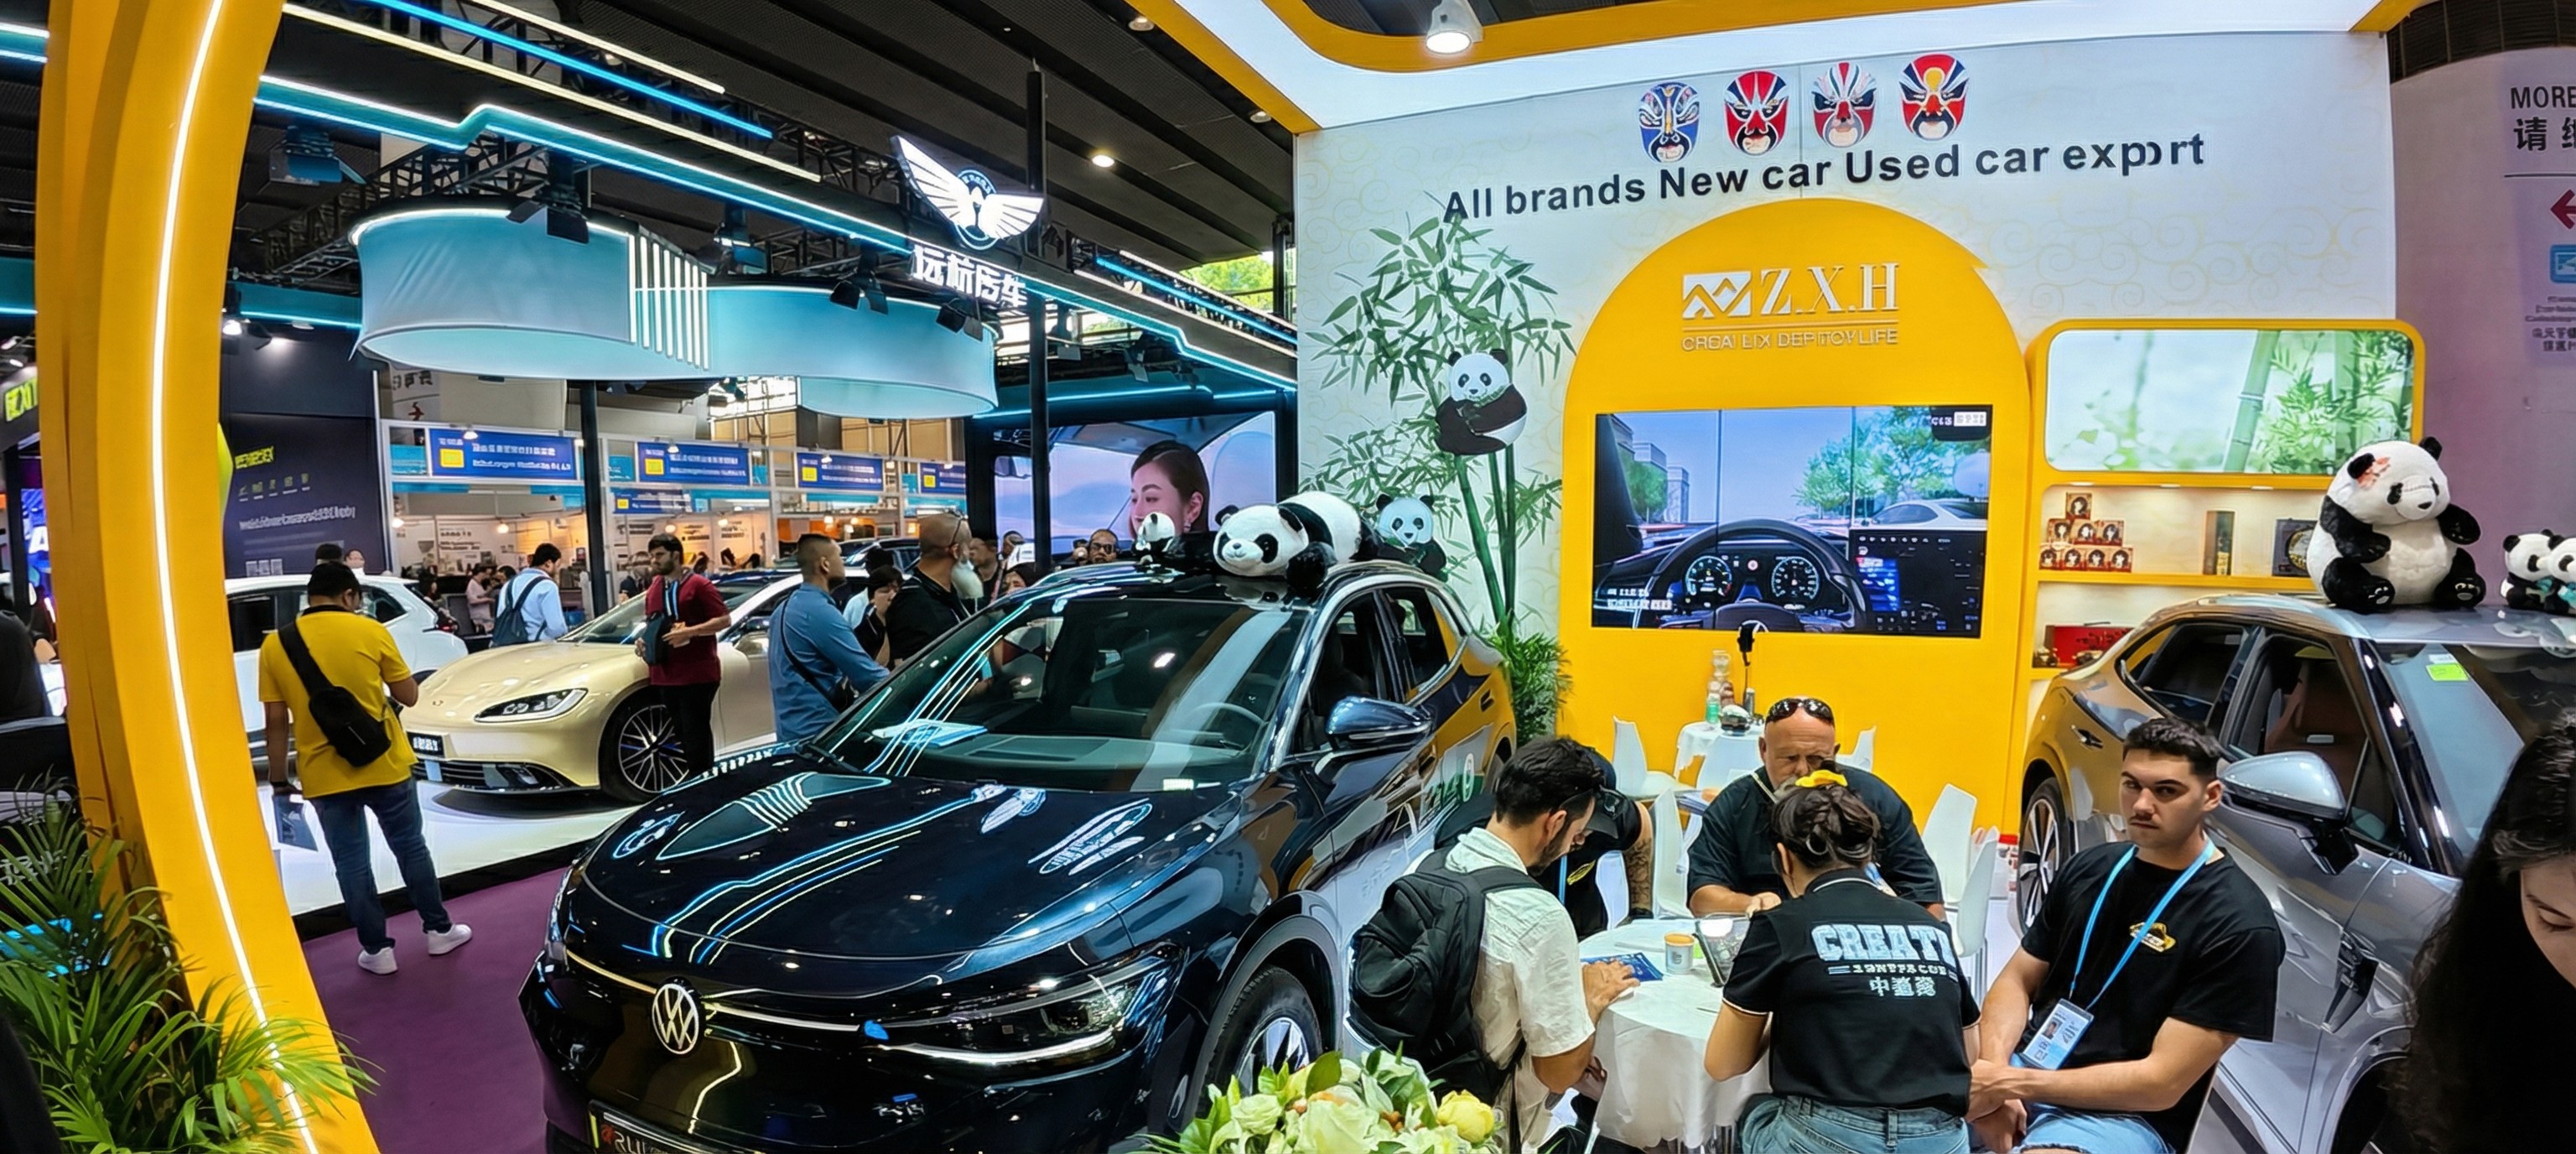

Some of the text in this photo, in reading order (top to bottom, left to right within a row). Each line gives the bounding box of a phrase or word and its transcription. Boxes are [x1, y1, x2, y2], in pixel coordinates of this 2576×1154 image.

[2511, 86, 2576, 109] MORE
[1443, 187, 1493, 223] All
[1506, 174, 1645, 215] brands
[1660, 167, 1748, 199] New
[1762, 161, 1832, 190] car
[1846, 144, 1959, 183] Used
[1975, 146, 2049, 175] car
[1759, 263, 1898, 315] Z.X.H
